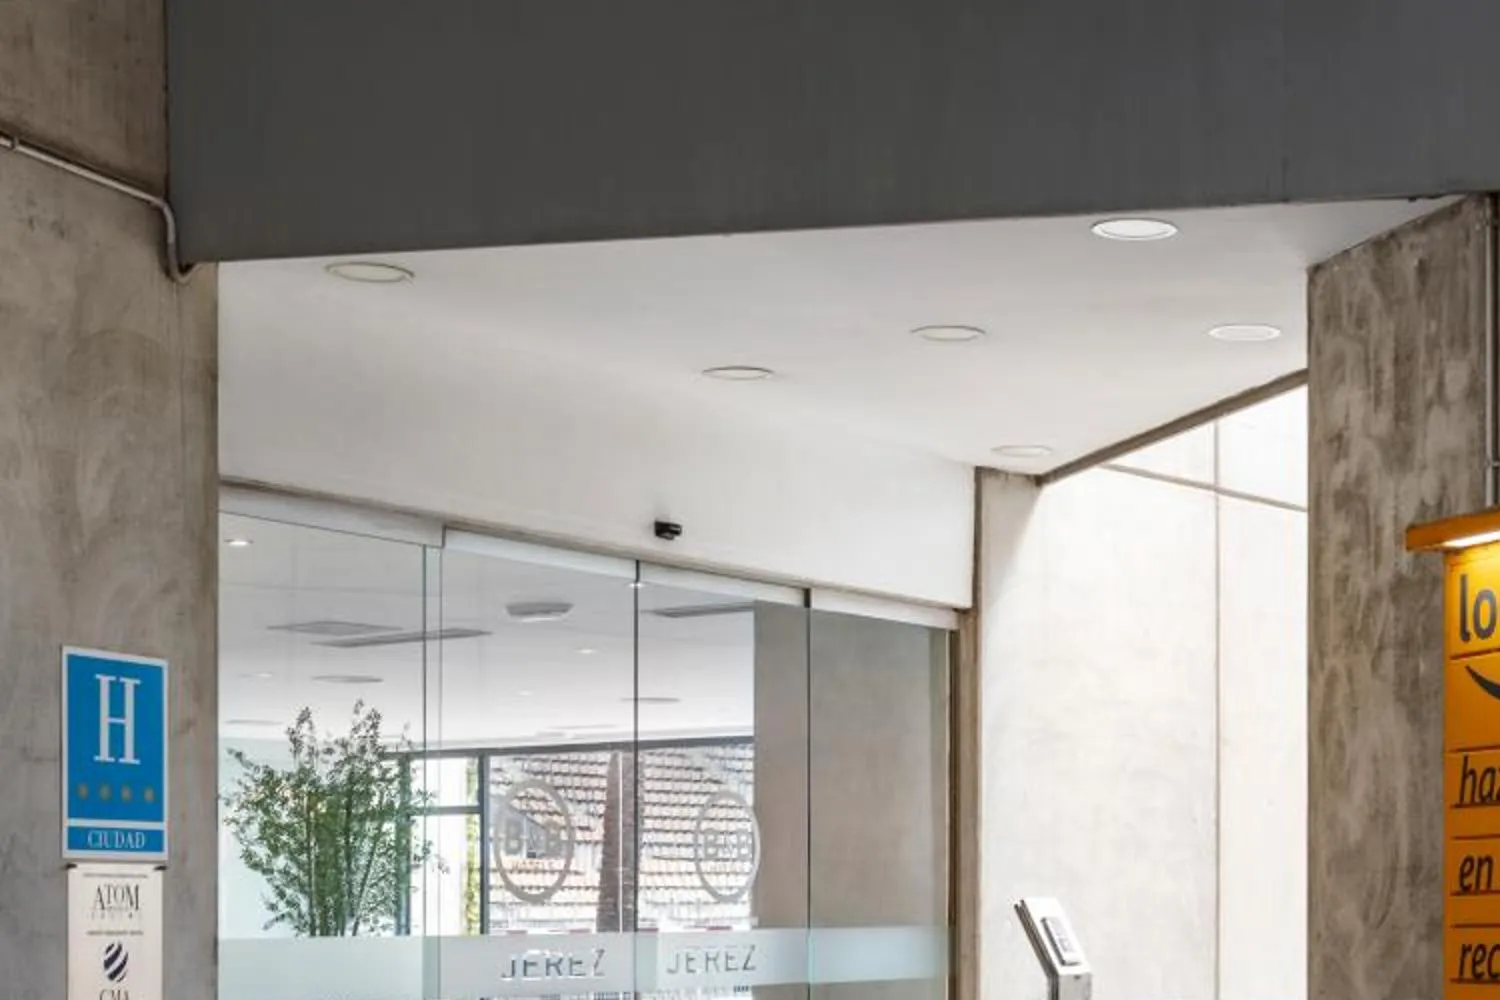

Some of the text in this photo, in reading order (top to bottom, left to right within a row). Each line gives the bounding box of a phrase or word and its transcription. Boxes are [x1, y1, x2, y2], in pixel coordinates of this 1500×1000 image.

[94, 673, 141, 765] H
[87, 828, 146, 850] CIUDAD
[1458, 854, 1493, 893] en
[93, 883, 140, 911] ATOM
[501, 948, 606, 980] JEREZ
[666, 944, 758, 975] JEREZ
